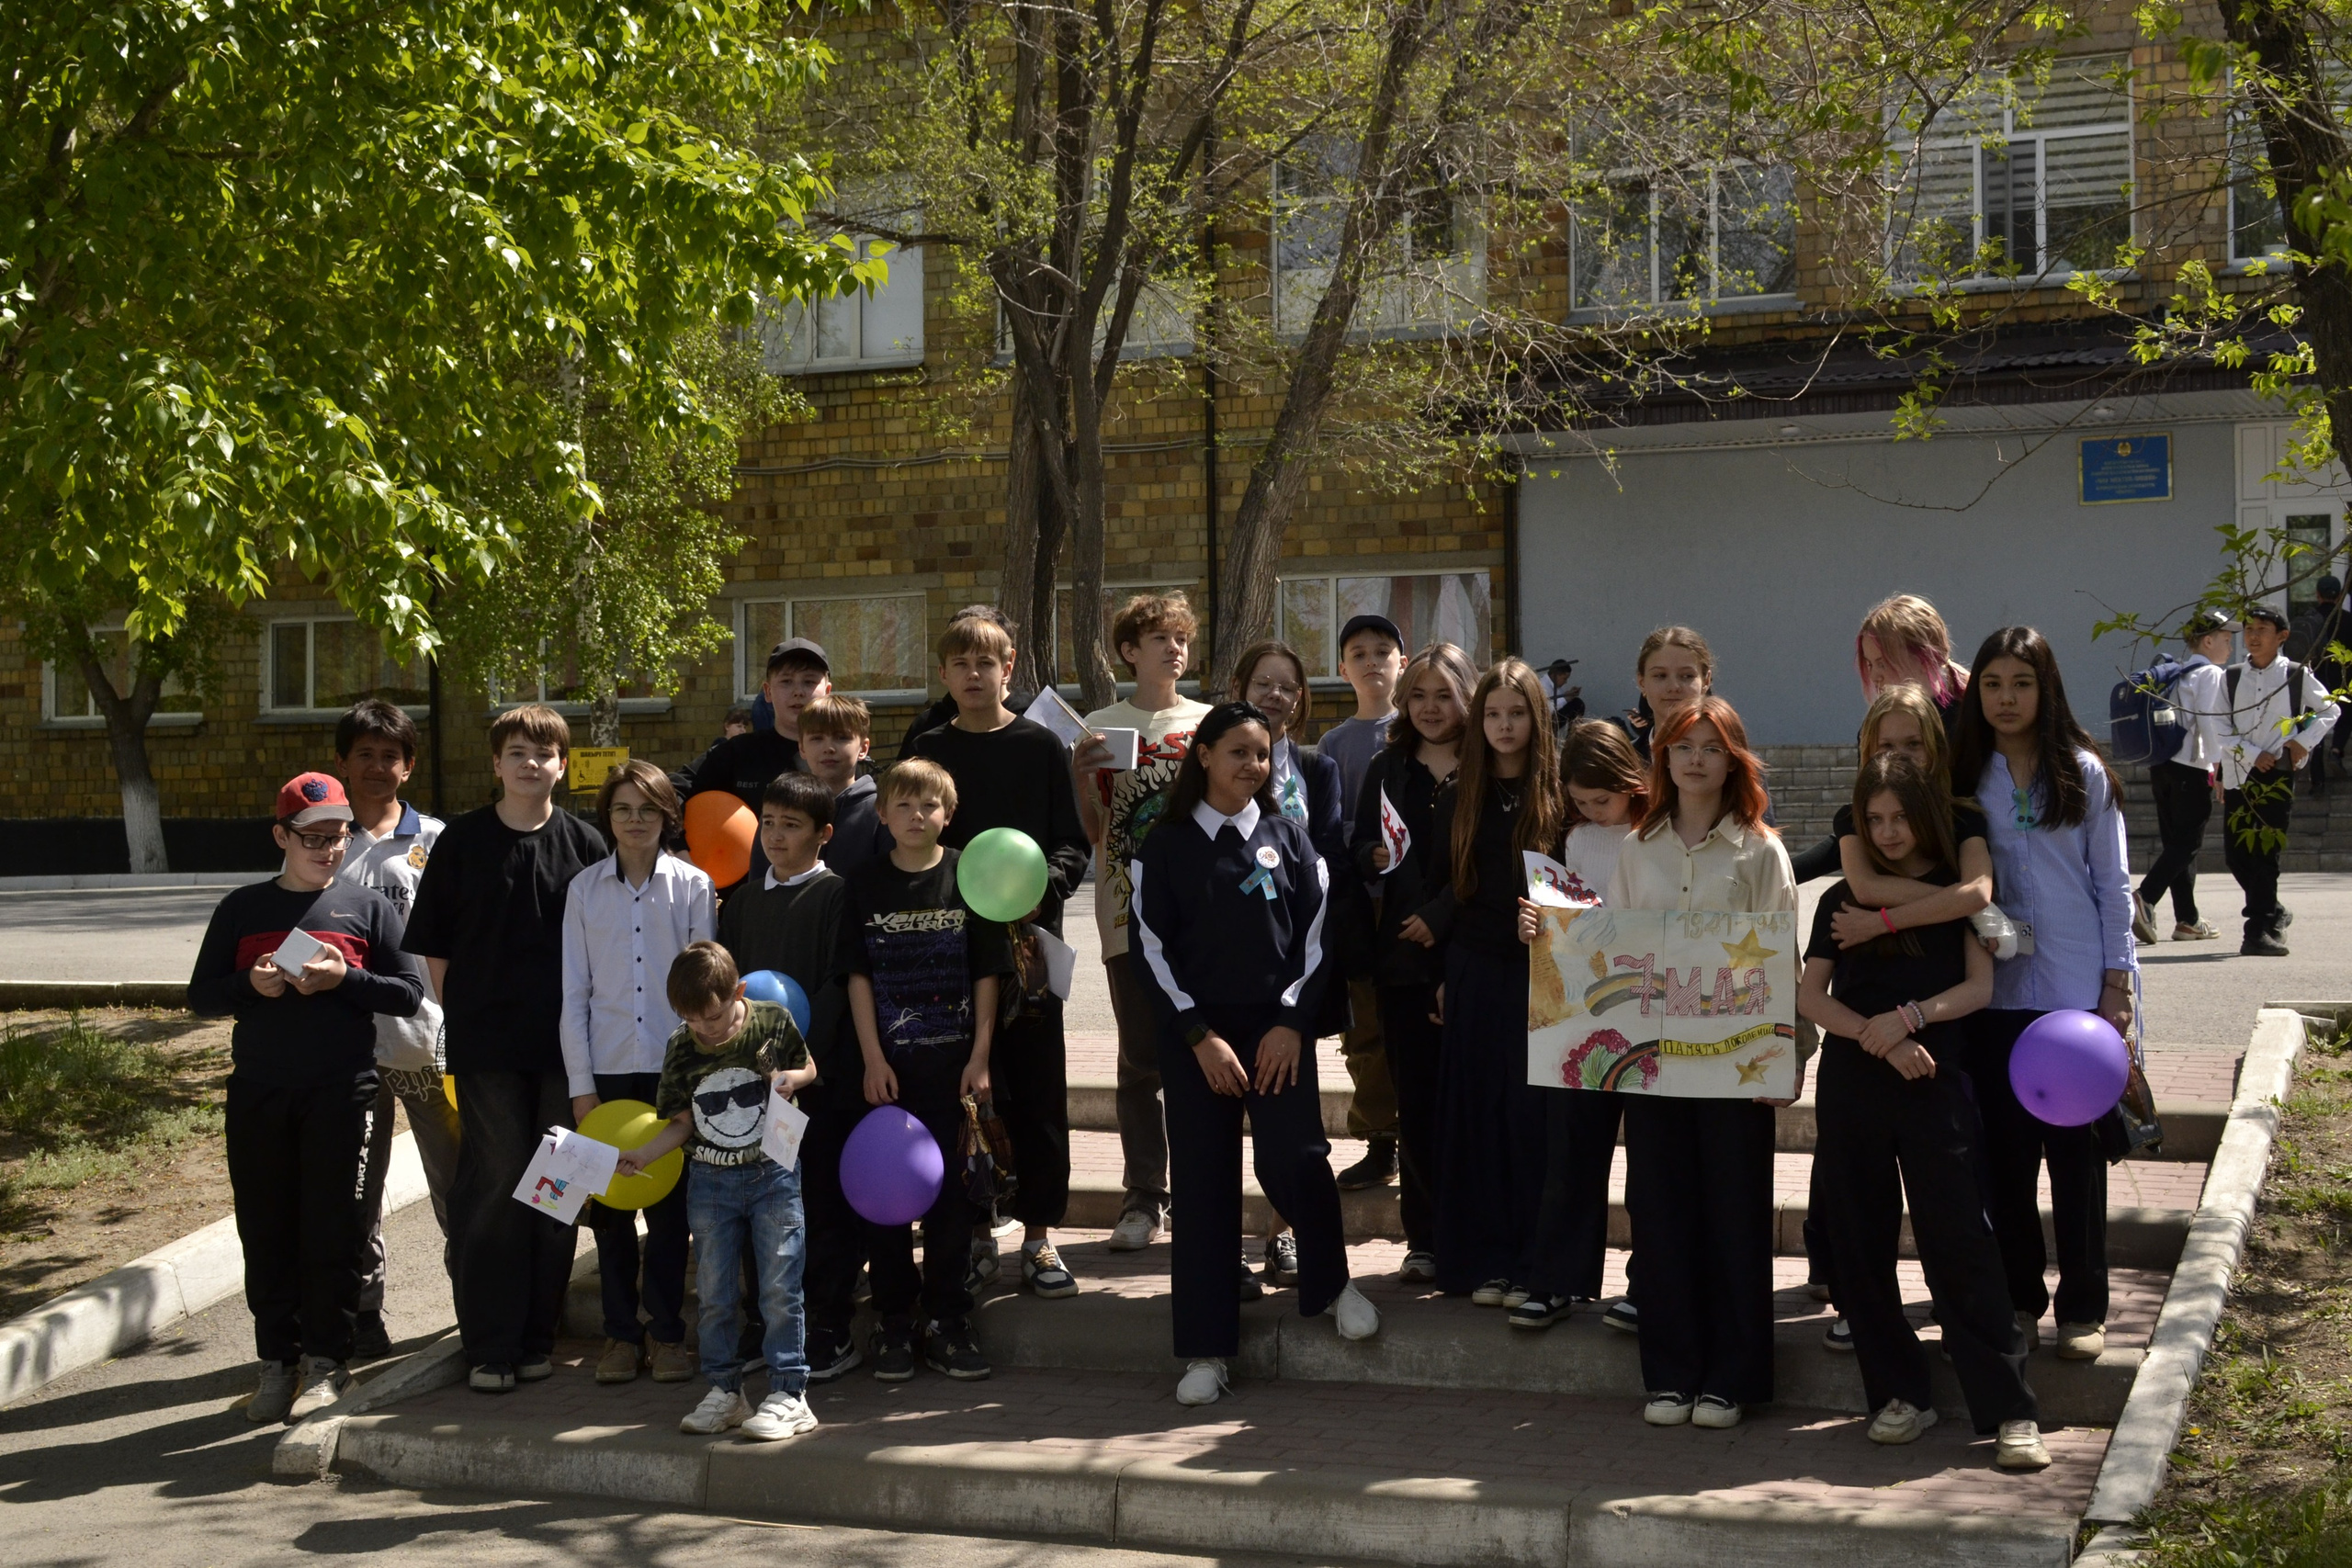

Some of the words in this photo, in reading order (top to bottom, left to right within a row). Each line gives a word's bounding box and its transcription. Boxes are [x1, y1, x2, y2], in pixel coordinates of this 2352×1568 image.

[1613, 953, 1657, 1014] 7
[1666, 967, 1765, 1016] МАЯ
[1664, 1040, 1720, 1055] ПАМЯТЬ
[355, 1160, 367, 1201] START
